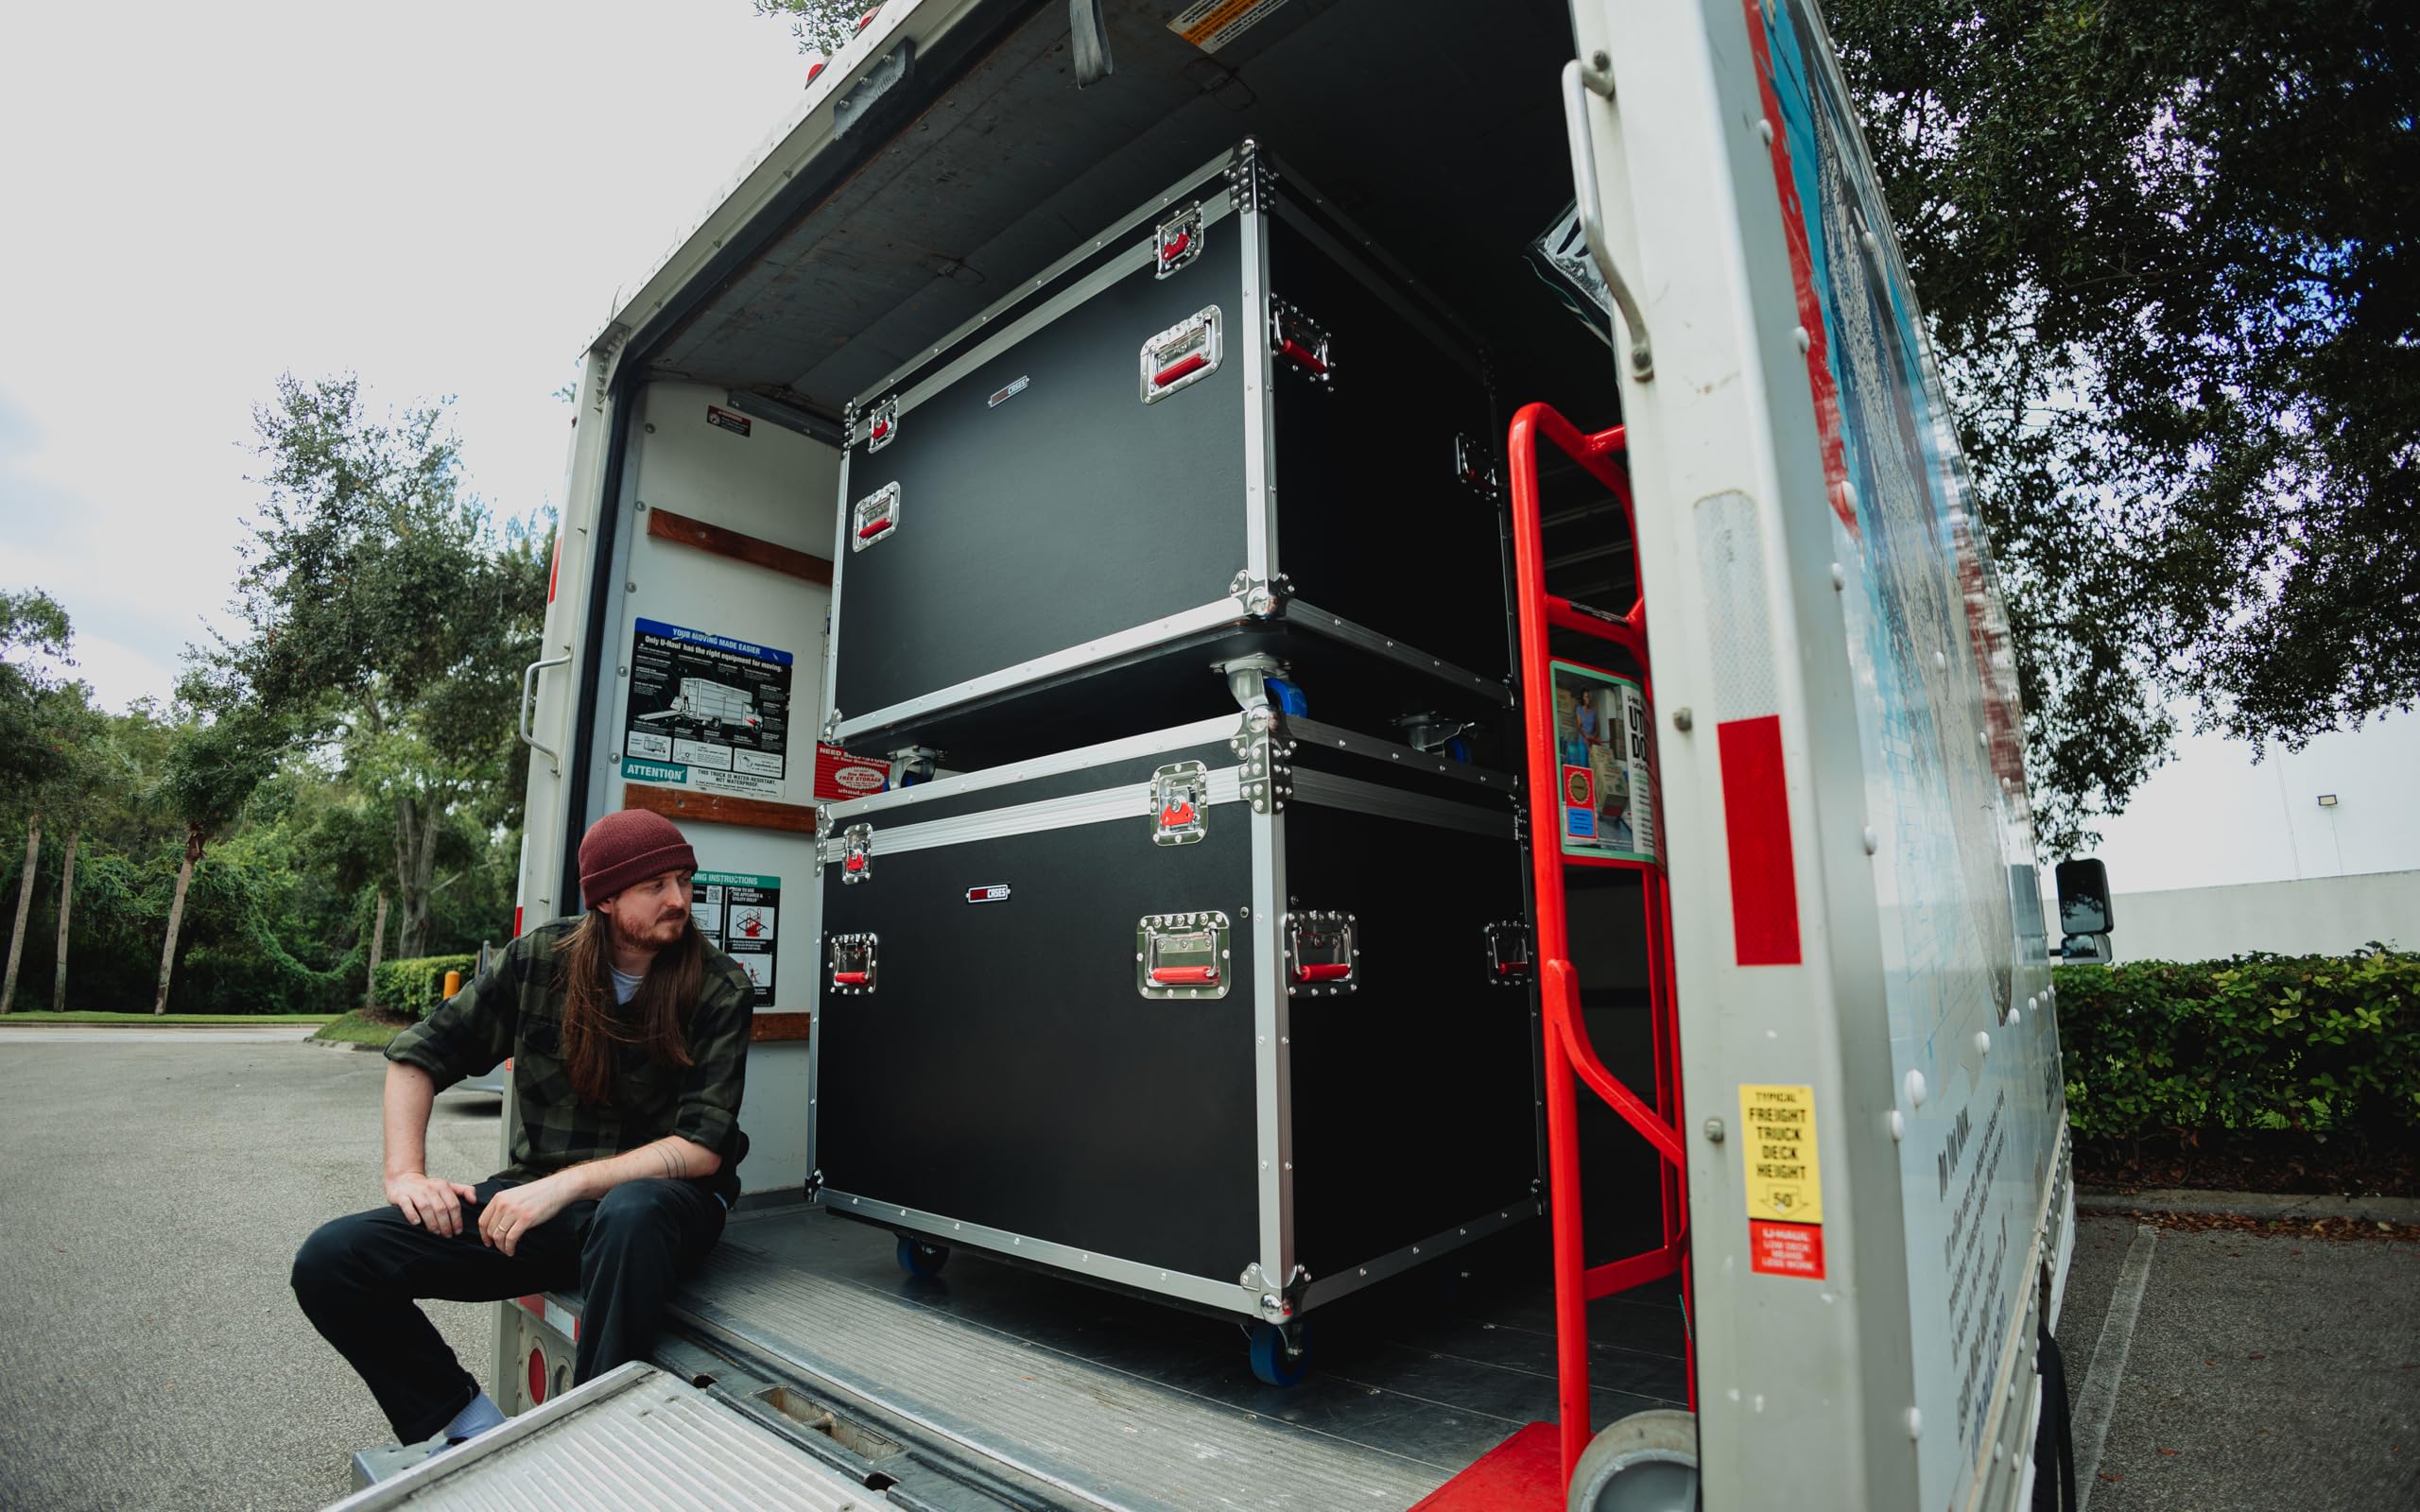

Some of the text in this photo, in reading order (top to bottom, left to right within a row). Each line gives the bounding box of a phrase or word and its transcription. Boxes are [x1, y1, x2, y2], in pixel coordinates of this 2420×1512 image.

[672, 627, 761, 655] YOUR MOVING MADE EASIER
[645, 635, 660, 646] Only
[660, 638, 681, 650] U-Haul
[683, 644, 694, 653] has
[695, 645, 705, 655] the
[706, 647, 720, 660] right
[721, 652, 752, 665] equipment
[752, 658, 761, 667] for
[819, 747, 842, 756] NEED
[627, 764, 683, 782] ATTENTION
[708, 874, 758, 885] INSTRUCTIONS
[1749, 1108, 1807, 1124] FREIGHT
[1756, 1125, 1803, 1143] TRUCK
[1761, 1144, 1799, 1161] DECK
[1755, 1163, 1806, 1180] HEIGHT
